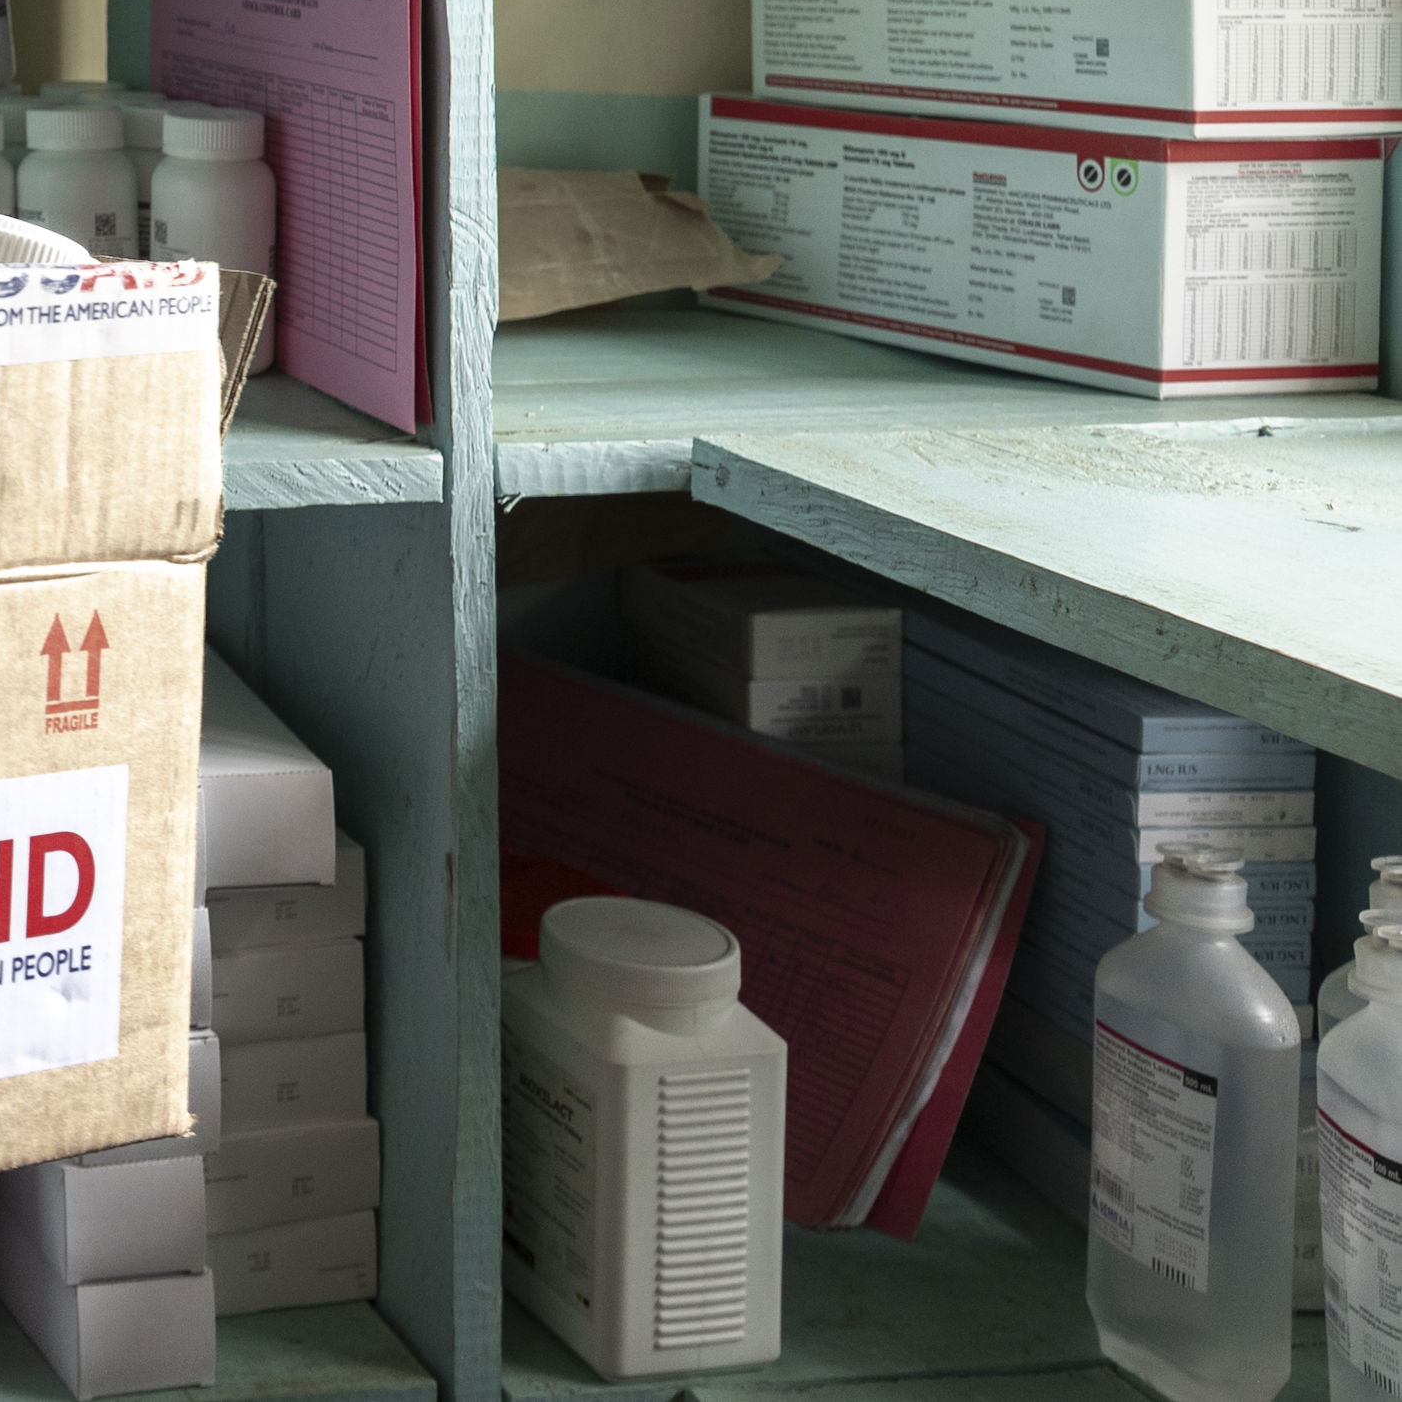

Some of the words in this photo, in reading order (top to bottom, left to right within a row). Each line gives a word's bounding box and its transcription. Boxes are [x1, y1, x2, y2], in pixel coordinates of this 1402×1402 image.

[28, 303, 61, 325] THE
[63, 299, 154, 323] AMERICAN
[158, 295, 213, 316] PEOPLE
[45, 713, 99, 736] FRAGILE
[1148, 764, 1175, 776] LNG
[1177, 763, 1198, 776] IUS
[1259, 880, 1280, 891] IUS
[1282, 880, 1311, 891] LNG
[1278, 914, 1307, 926] LNG
[1276, 950, 1304, 962] LNG
[11, 945, 92, 983] PEOPLE
[1153, 1061, 1182, 1082] Lactate
[1184, 1075, 1199, 1089] 500
[1374, 1162, 1387, 1176] 500
